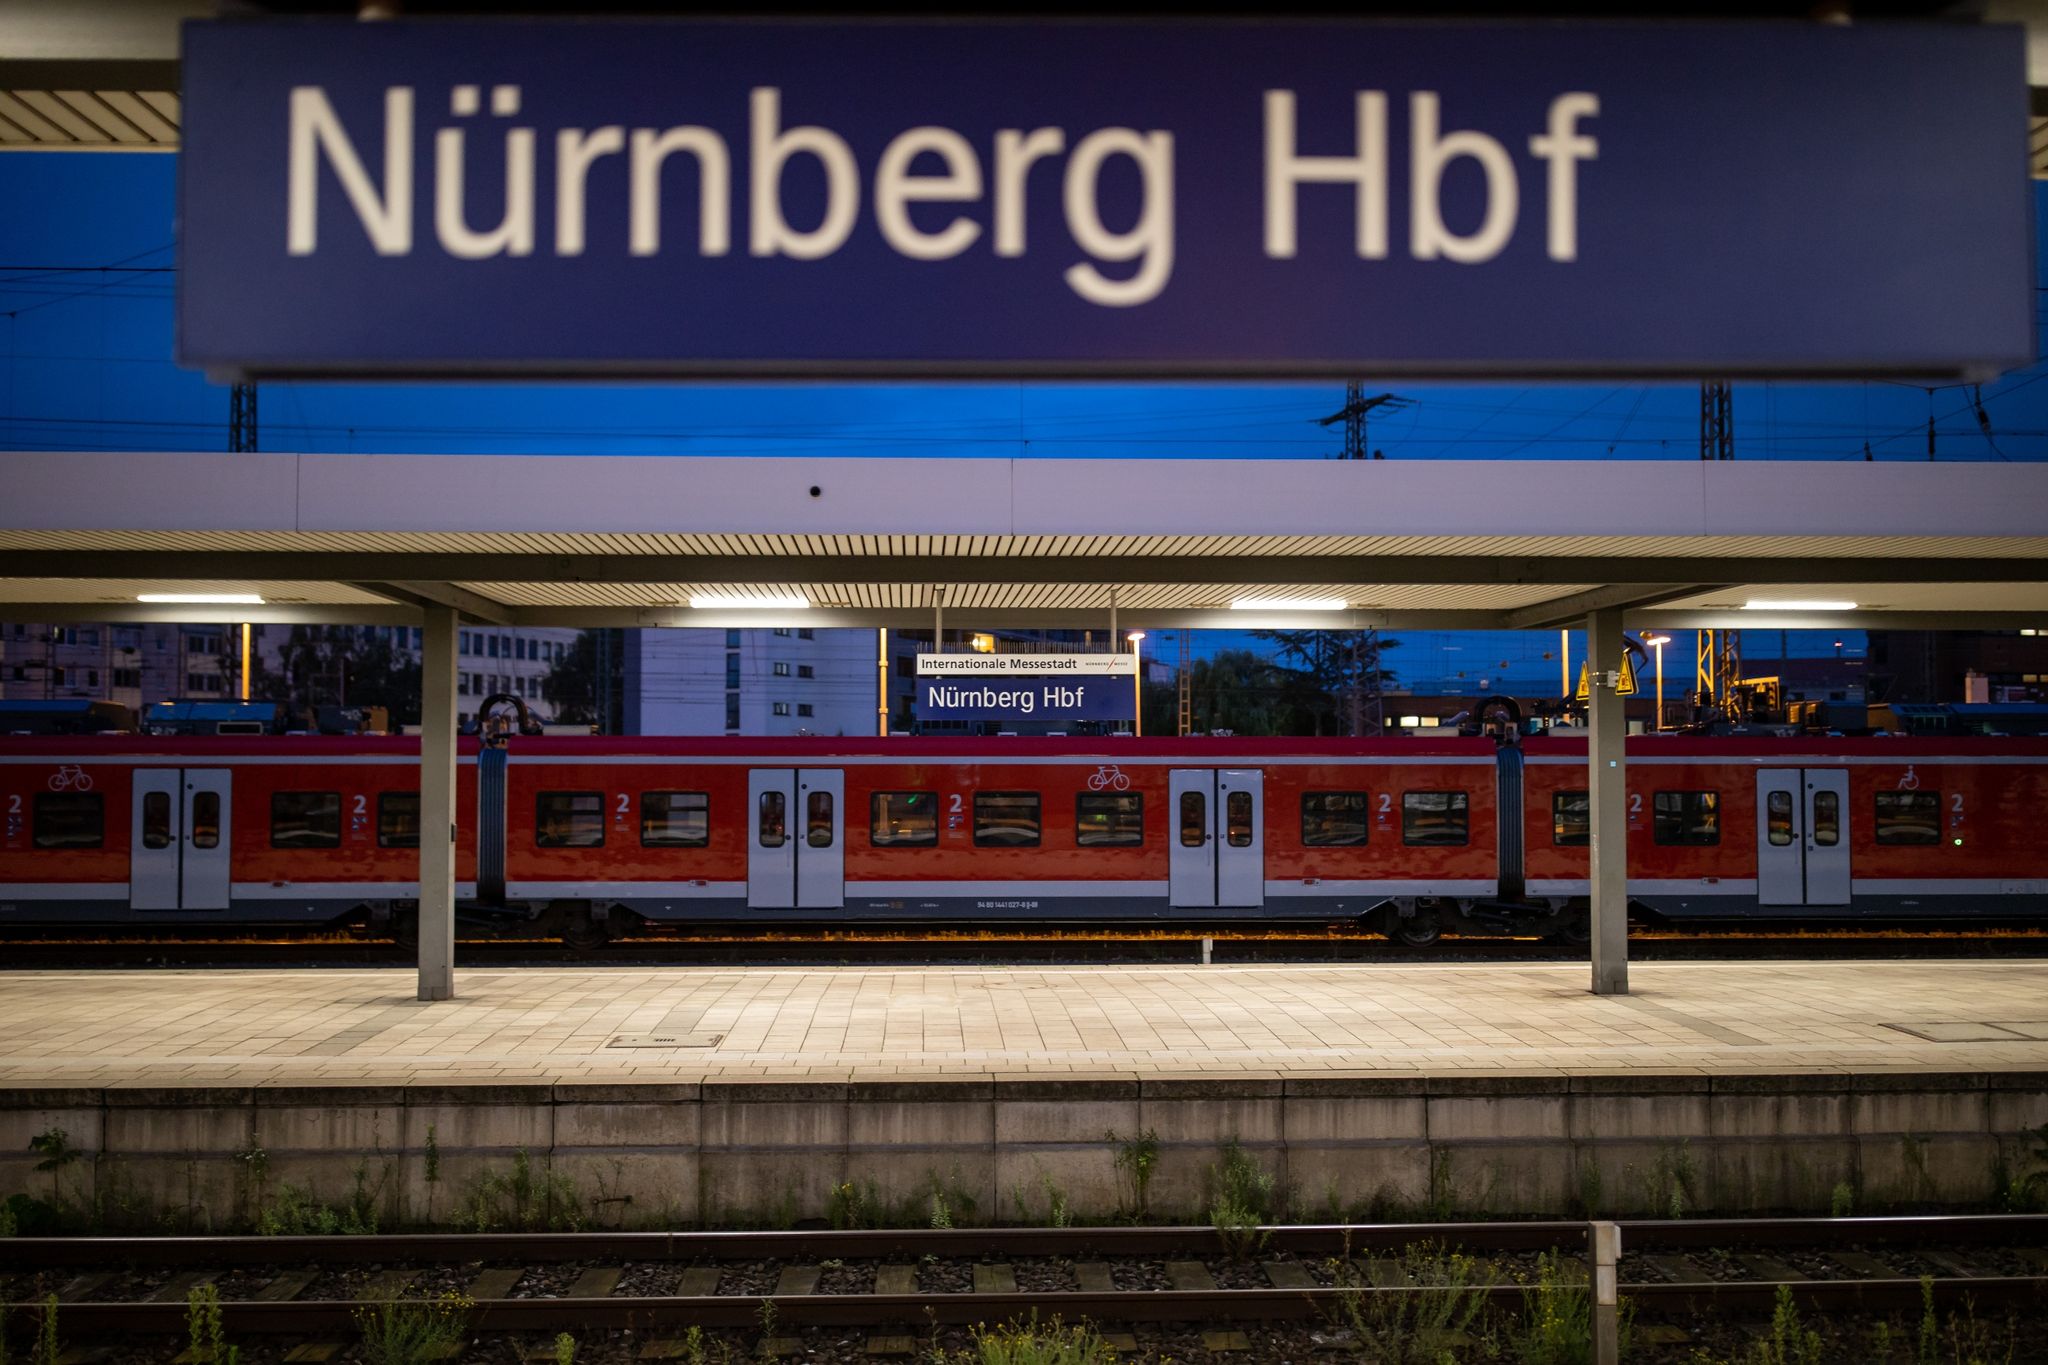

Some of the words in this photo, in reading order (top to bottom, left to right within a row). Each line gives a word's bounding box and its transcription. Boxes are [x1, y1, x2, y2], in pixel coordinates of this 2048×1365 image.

[286, 84, 1176, 308] Nürnberg
[1262, 89, 1600, 264] Hbf
[921, 658, 1006, 669] Internationale
[1010, 658, 1077, 669] Messestadt
[928, 686, 1035, 713] Nürnberg
[1043, 686, 1085, 708] Hbf
[8, 795, 22, 813] 2
[352, 795, 367, 813] 2
[616, 793, 630, 812] 2
[949, 793, 963, 812] 2
[1378, 793, 1392, 812] 2
[1629, 793, 1643, 812] 2
[1951, 793, 1965, 812] 2
